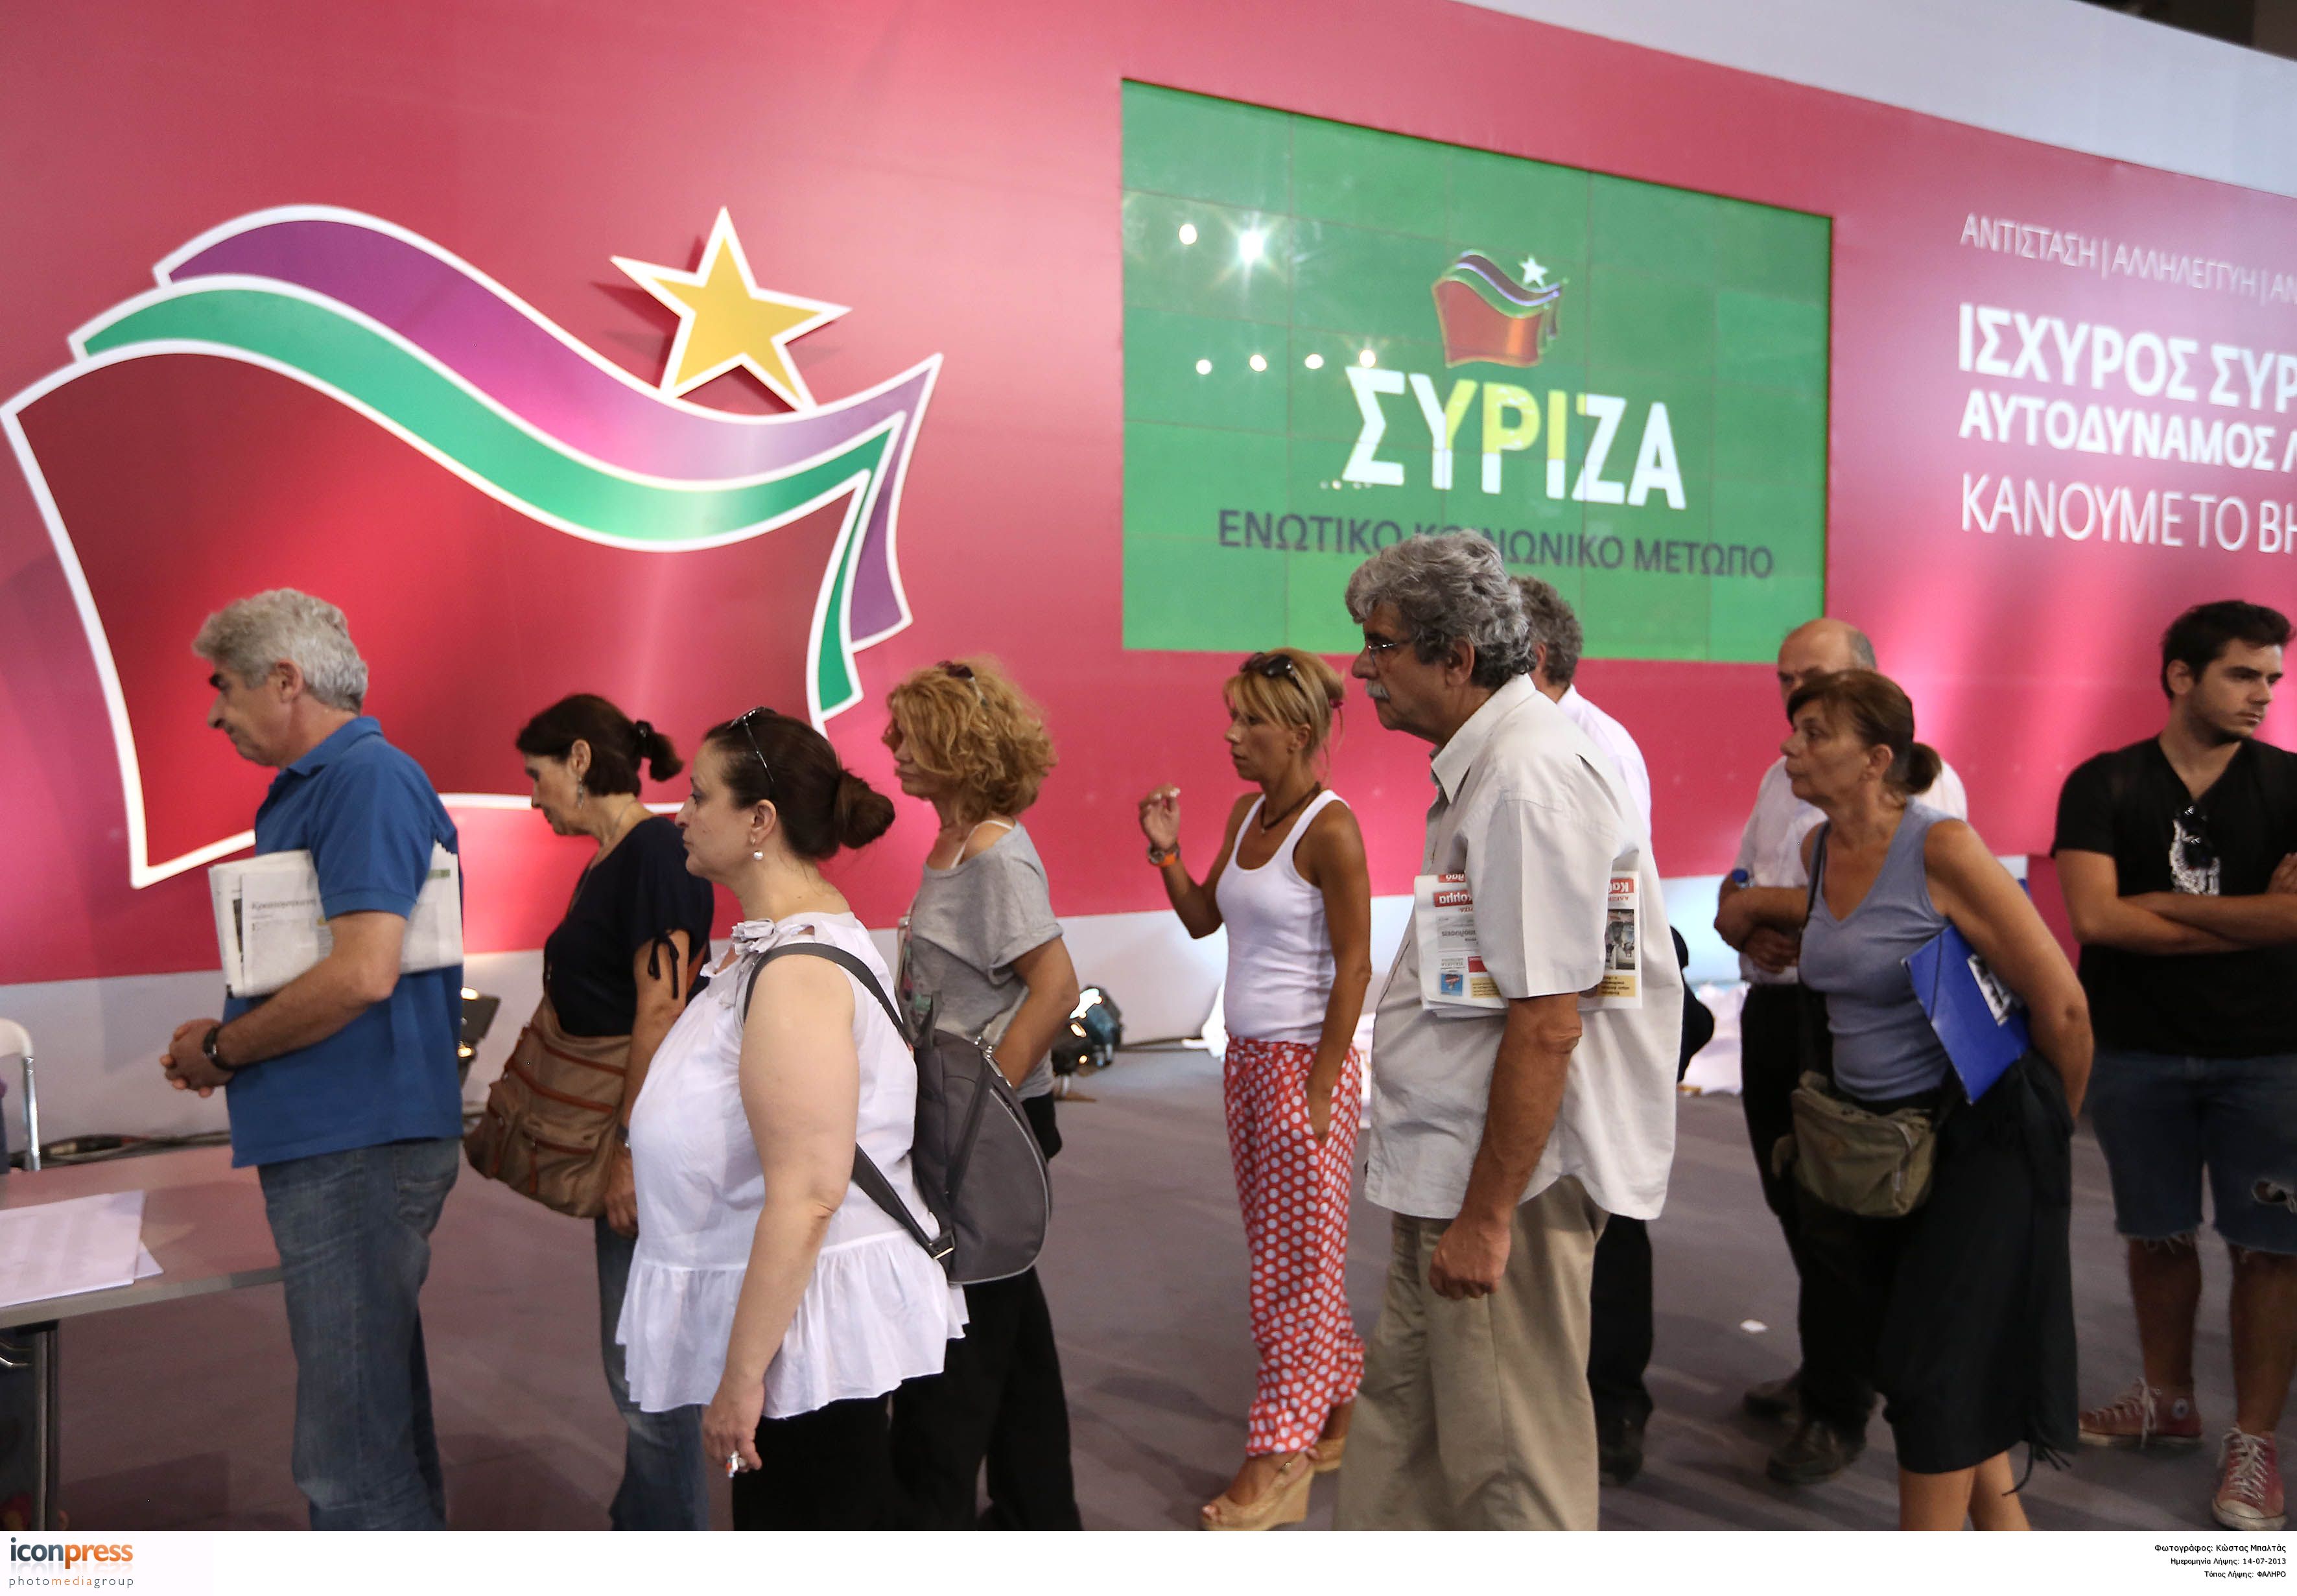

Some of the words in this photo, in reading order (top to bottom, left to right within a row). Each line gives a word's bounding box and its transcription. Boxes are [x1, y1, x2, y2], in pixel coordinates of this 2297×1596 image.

[1960, 212, 2097, 270] ΑΝΤΙΣΤΑΣΗ
[1959, 301, 2198, 402] ΙΣΧΥΡΟΣ
[2209, 342, 2297, 414] ΣΥΡ
[1341, 366, 1686, 510] ΣΥΡΙΖΑ
[1959, 388, 2276, 472] ΑΥΤΟΔΥΝΑΜΟΣ
[1217, 508, 1403, 556] ΕΝΩΤΙΚΟ
[1633, 538, 1775, 580] ΜΕΤΩΠΟ
[1961, 472, 2184, 547] ΚΑΝΟΥΜΕ
[2189, 493, 2249, 552] ΤΟ
